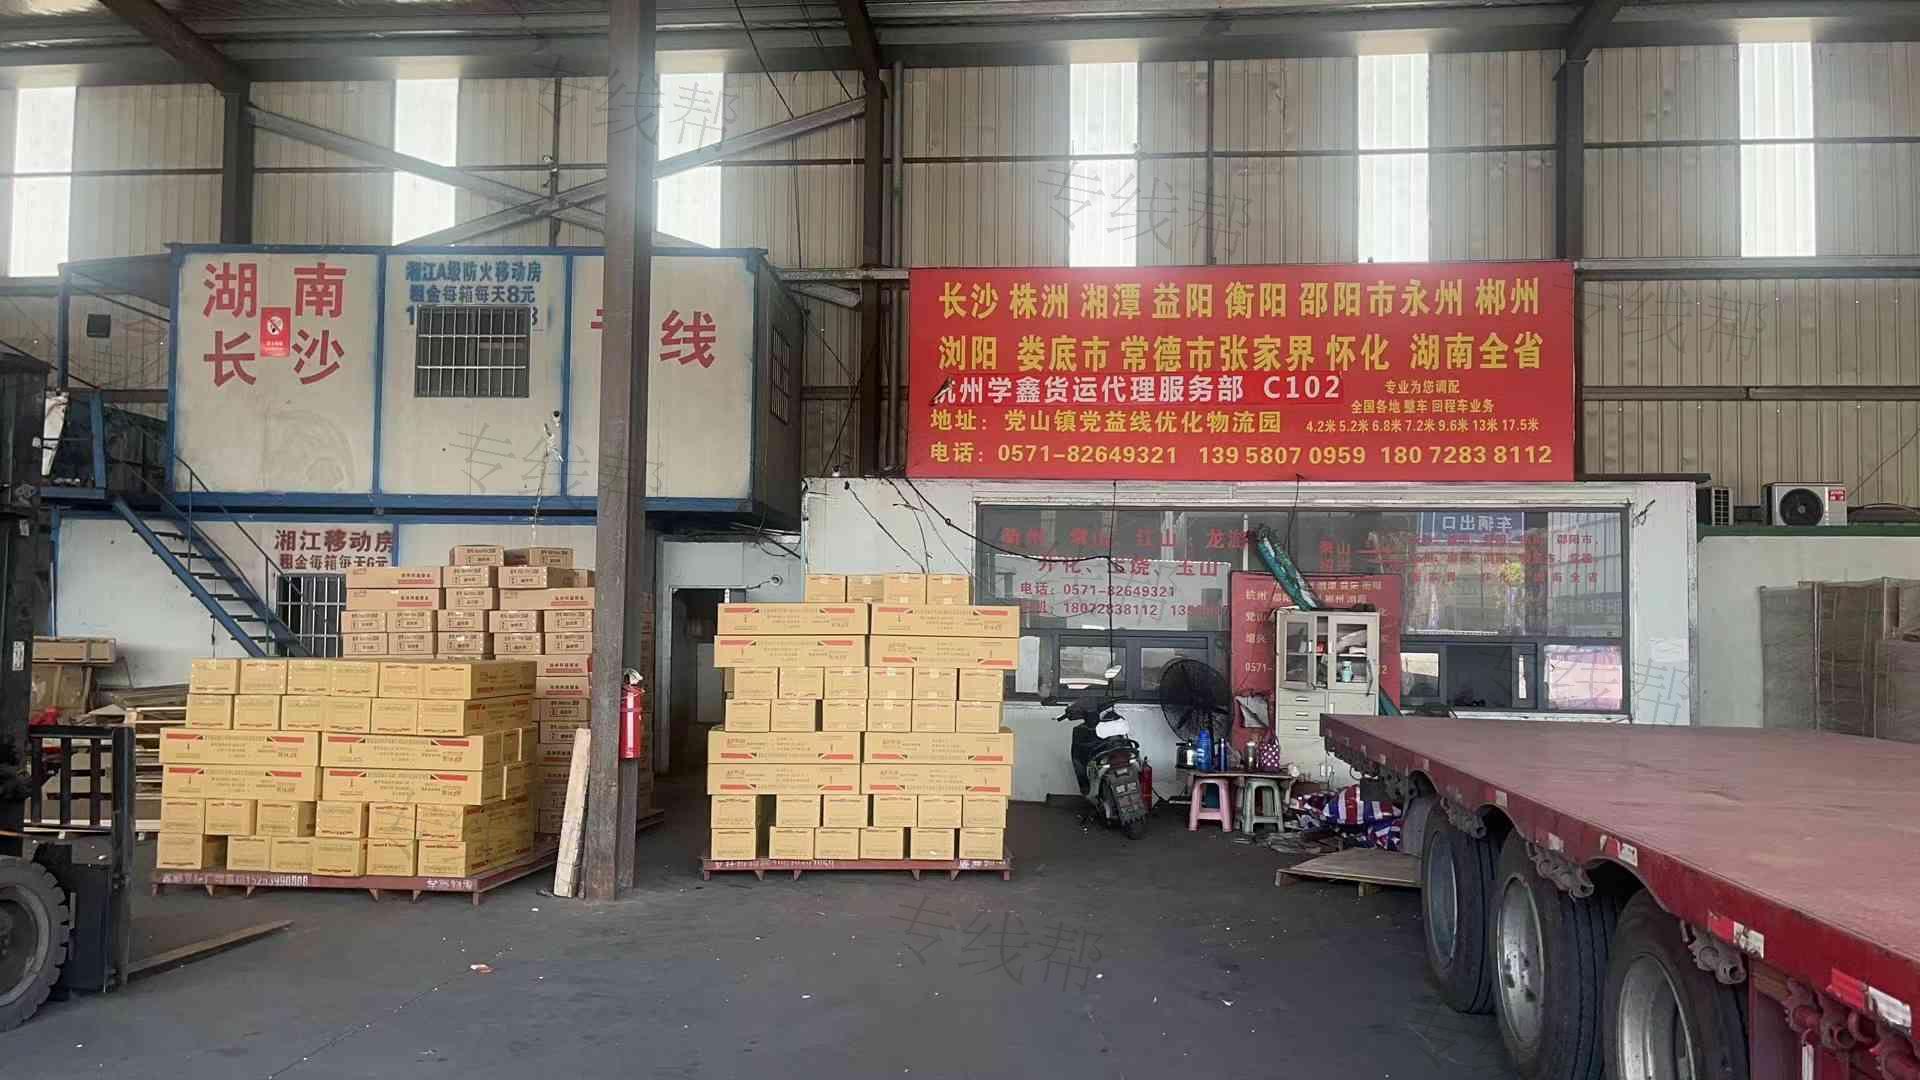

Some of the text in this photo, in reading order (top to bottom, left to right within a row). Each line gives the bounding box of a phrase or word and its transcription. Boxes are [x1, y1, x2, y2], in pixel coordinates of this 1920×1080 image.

[406, 261, 542, 282] 湘江A级防火移动房
[202, 262, 347, 319] 湖南
[410, 284, 536, 303] 租金每箱每天8元
[939, 282, 999, 319] 长沙
[1009, 282, 1068, 319] 株洲
[1080, 282, 1141, 319] 湘潭
[1152, 281, 1213, 319] 益阳
[1225, 281, 1287, 319] 衡阳
[1475, 278, 1539, 315] 郴州
[203, 330, 345, 387] 长沙
[938, 332, 1544, 372] 浏阳 娄底市 常德市张家界 怀化 湖南全省
[1264, 375, 1340, 399] C102
[1384, 379, 1460, 394] 专业为您调配
[1351, 399, 1400, 414] 全国各地
[1432, 398, 1494, 413] 回程车业务
[1005, 409, 1281, 434] 党山镇党益线优化物流园
[1306, 417, 1540, 433] 4.2米 5.2米 6.8米 7.2米 9.6米 13米 17.5米
[998, 445, 1177, 464] 0571-82649321
[274, 528, 393, 552] 湘江移动房
